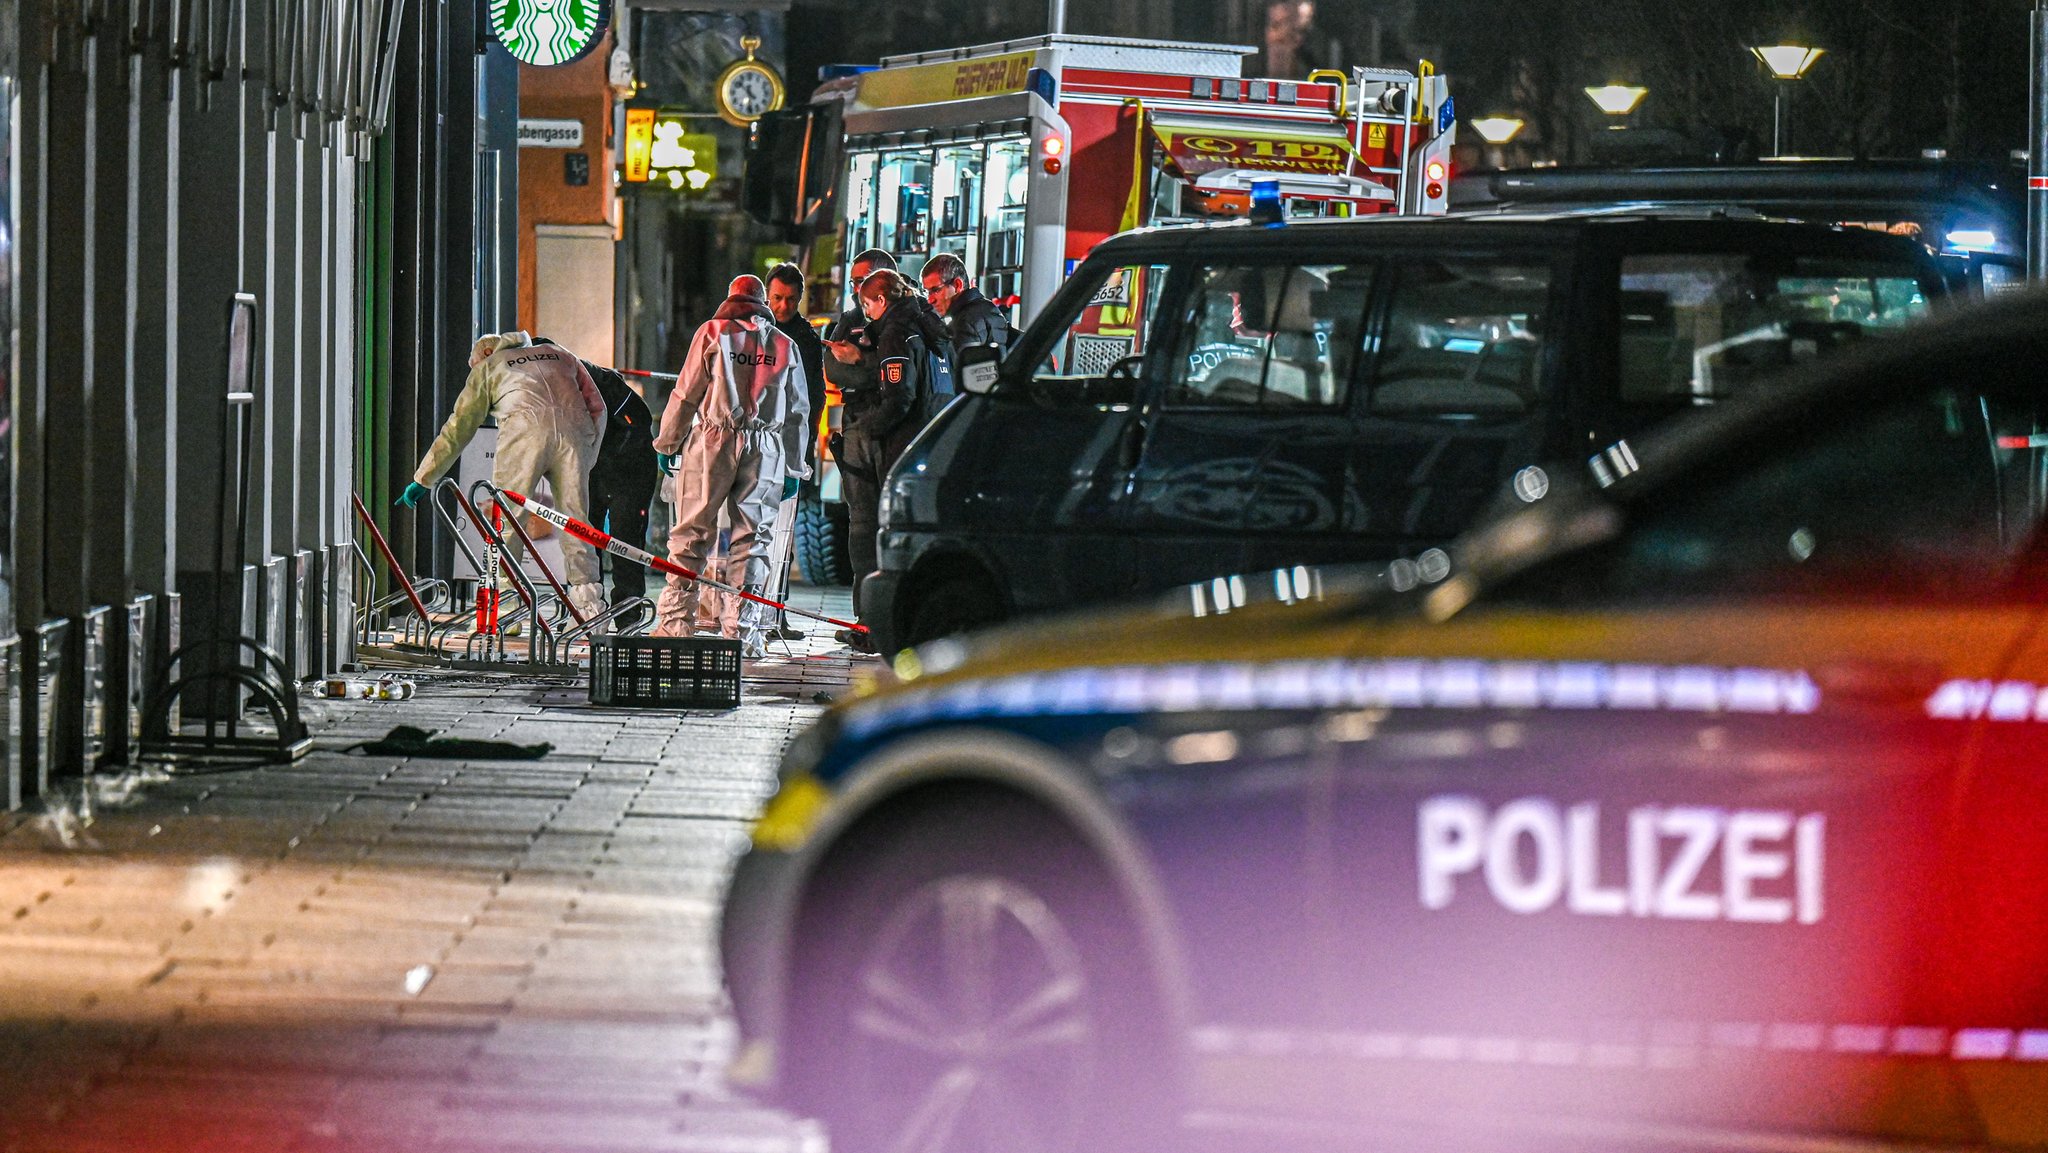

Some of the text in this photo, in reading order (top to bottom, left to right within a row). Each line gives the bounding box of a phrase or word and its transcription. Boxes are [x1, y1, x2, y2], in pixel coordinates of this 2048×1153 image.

[517, 125, 579, 142] abengasse
[1248, 141, 1340, 160] 112
[1195, 154, 1346, 171] FEUERWEHR
[507, 353, 560, 367] POLIZEI
[729, 351, 777, 367] POLIZEI
[1417, 796, 1825, 924] POLIZEI
